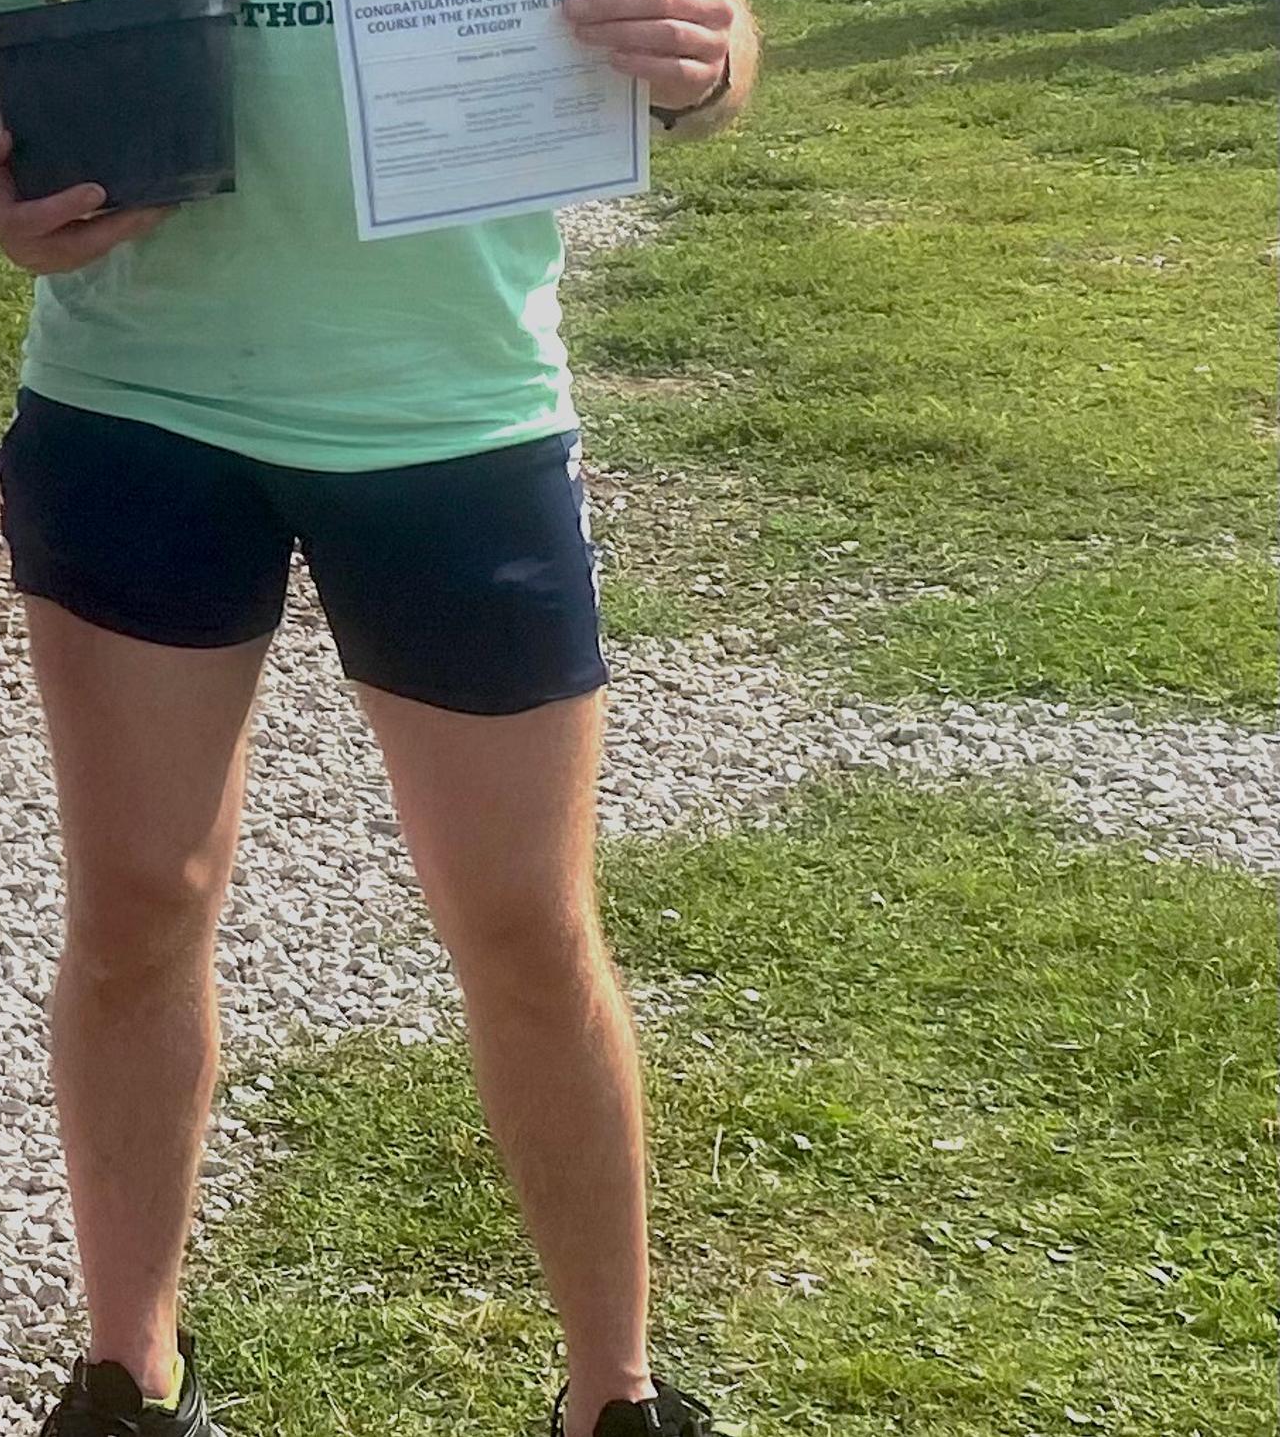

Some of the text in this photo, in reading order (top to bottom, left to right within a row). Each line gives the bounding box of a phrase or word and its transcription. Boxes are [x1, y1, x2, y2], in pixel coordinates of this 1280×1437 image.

[367, 16, 418, 34] COURSE
[422, 14, 436, 27] IN
[440, 10, 463, 24] THE
[467, 2, 517, 20] FASTEST
[457, 18, 522, 37] CATEGORY
